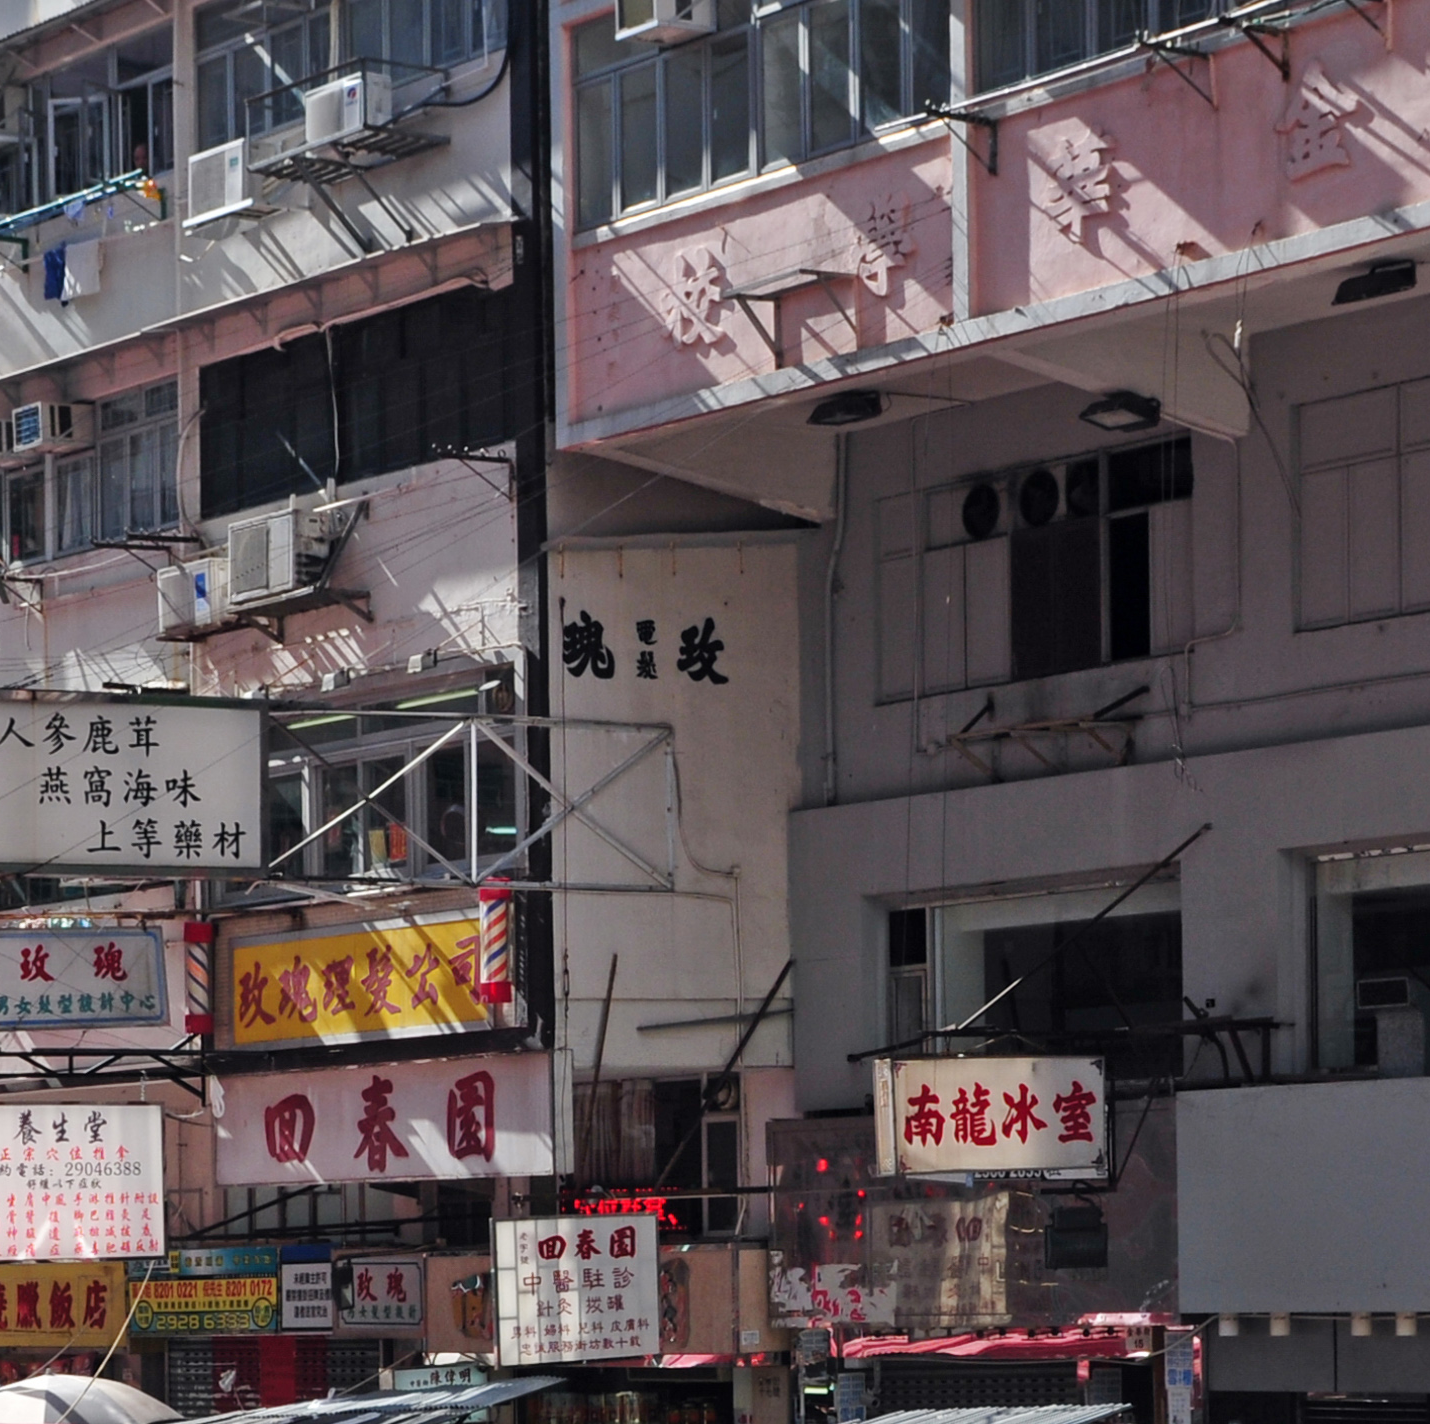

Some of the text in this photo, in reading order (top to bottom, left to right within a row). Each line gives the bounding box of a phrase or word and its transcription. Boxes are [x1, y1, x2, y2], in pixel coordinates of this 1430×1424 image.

[39, 765, 203, 806] 燕窩海味
[86, 818, 247, 860] 上等藥材
[20, 941, 128, 982] 玫瑰
[239, 935, 487, 1028] 玫瑰理髮公司
[14, 1109, 107, 1146] 養生堂
[264, 1070, 495, 1173] 回春園
[904, 1081, 1097, 1147] 南龍冰室
[0, 1145, 129, 1162] 正宗穴位推拿
[64, 1161, 142, 1177] 29046388
[538, 1225, 636, 1260] 回春園
[357, 1266, 407, 1303] 玫瑰
[523, 1266, 635, 1296] 中醫駐診
